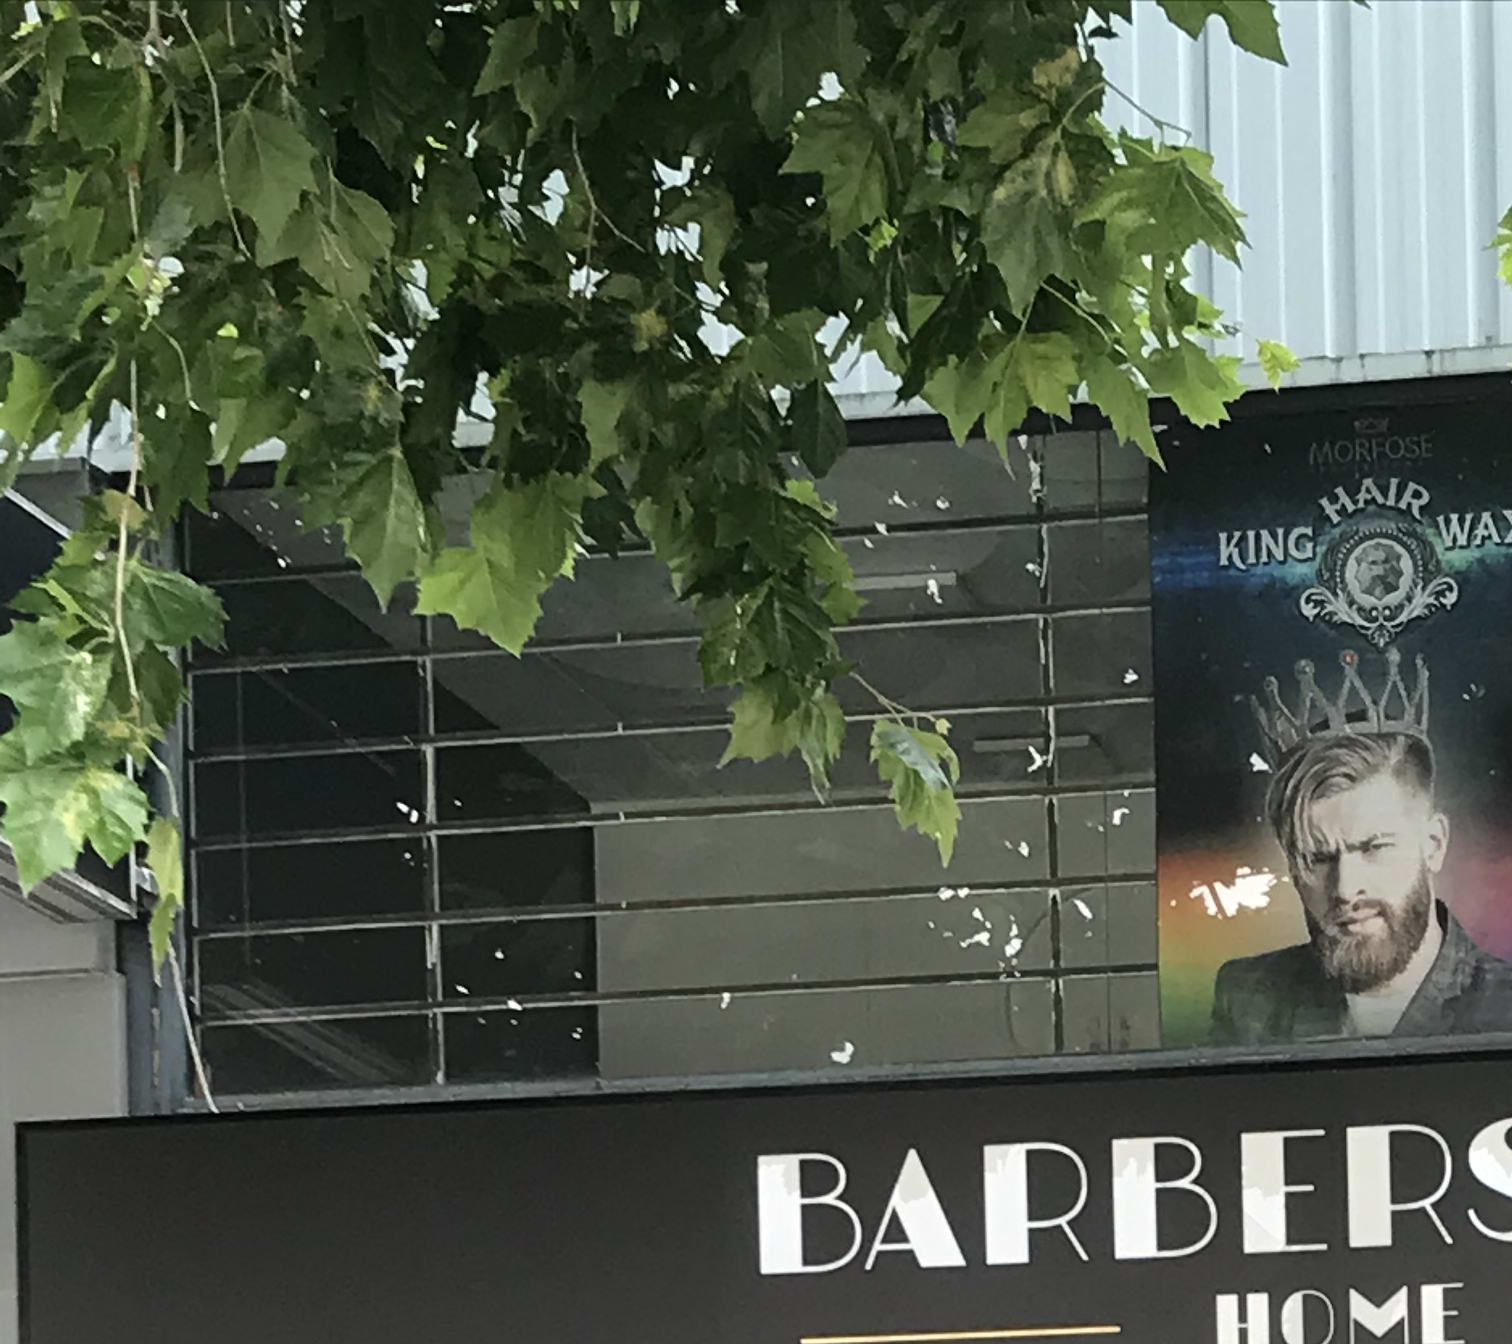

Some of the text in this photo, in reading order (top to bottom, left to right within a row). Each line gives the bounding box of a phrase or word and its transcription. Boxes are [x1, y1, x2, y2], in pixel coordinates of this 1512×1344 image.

[1308, 434, 1434, 466] MORFOSE
[1218, 525, 1314, 570] KING
[1318, 477, 1431, 525] HAIR
